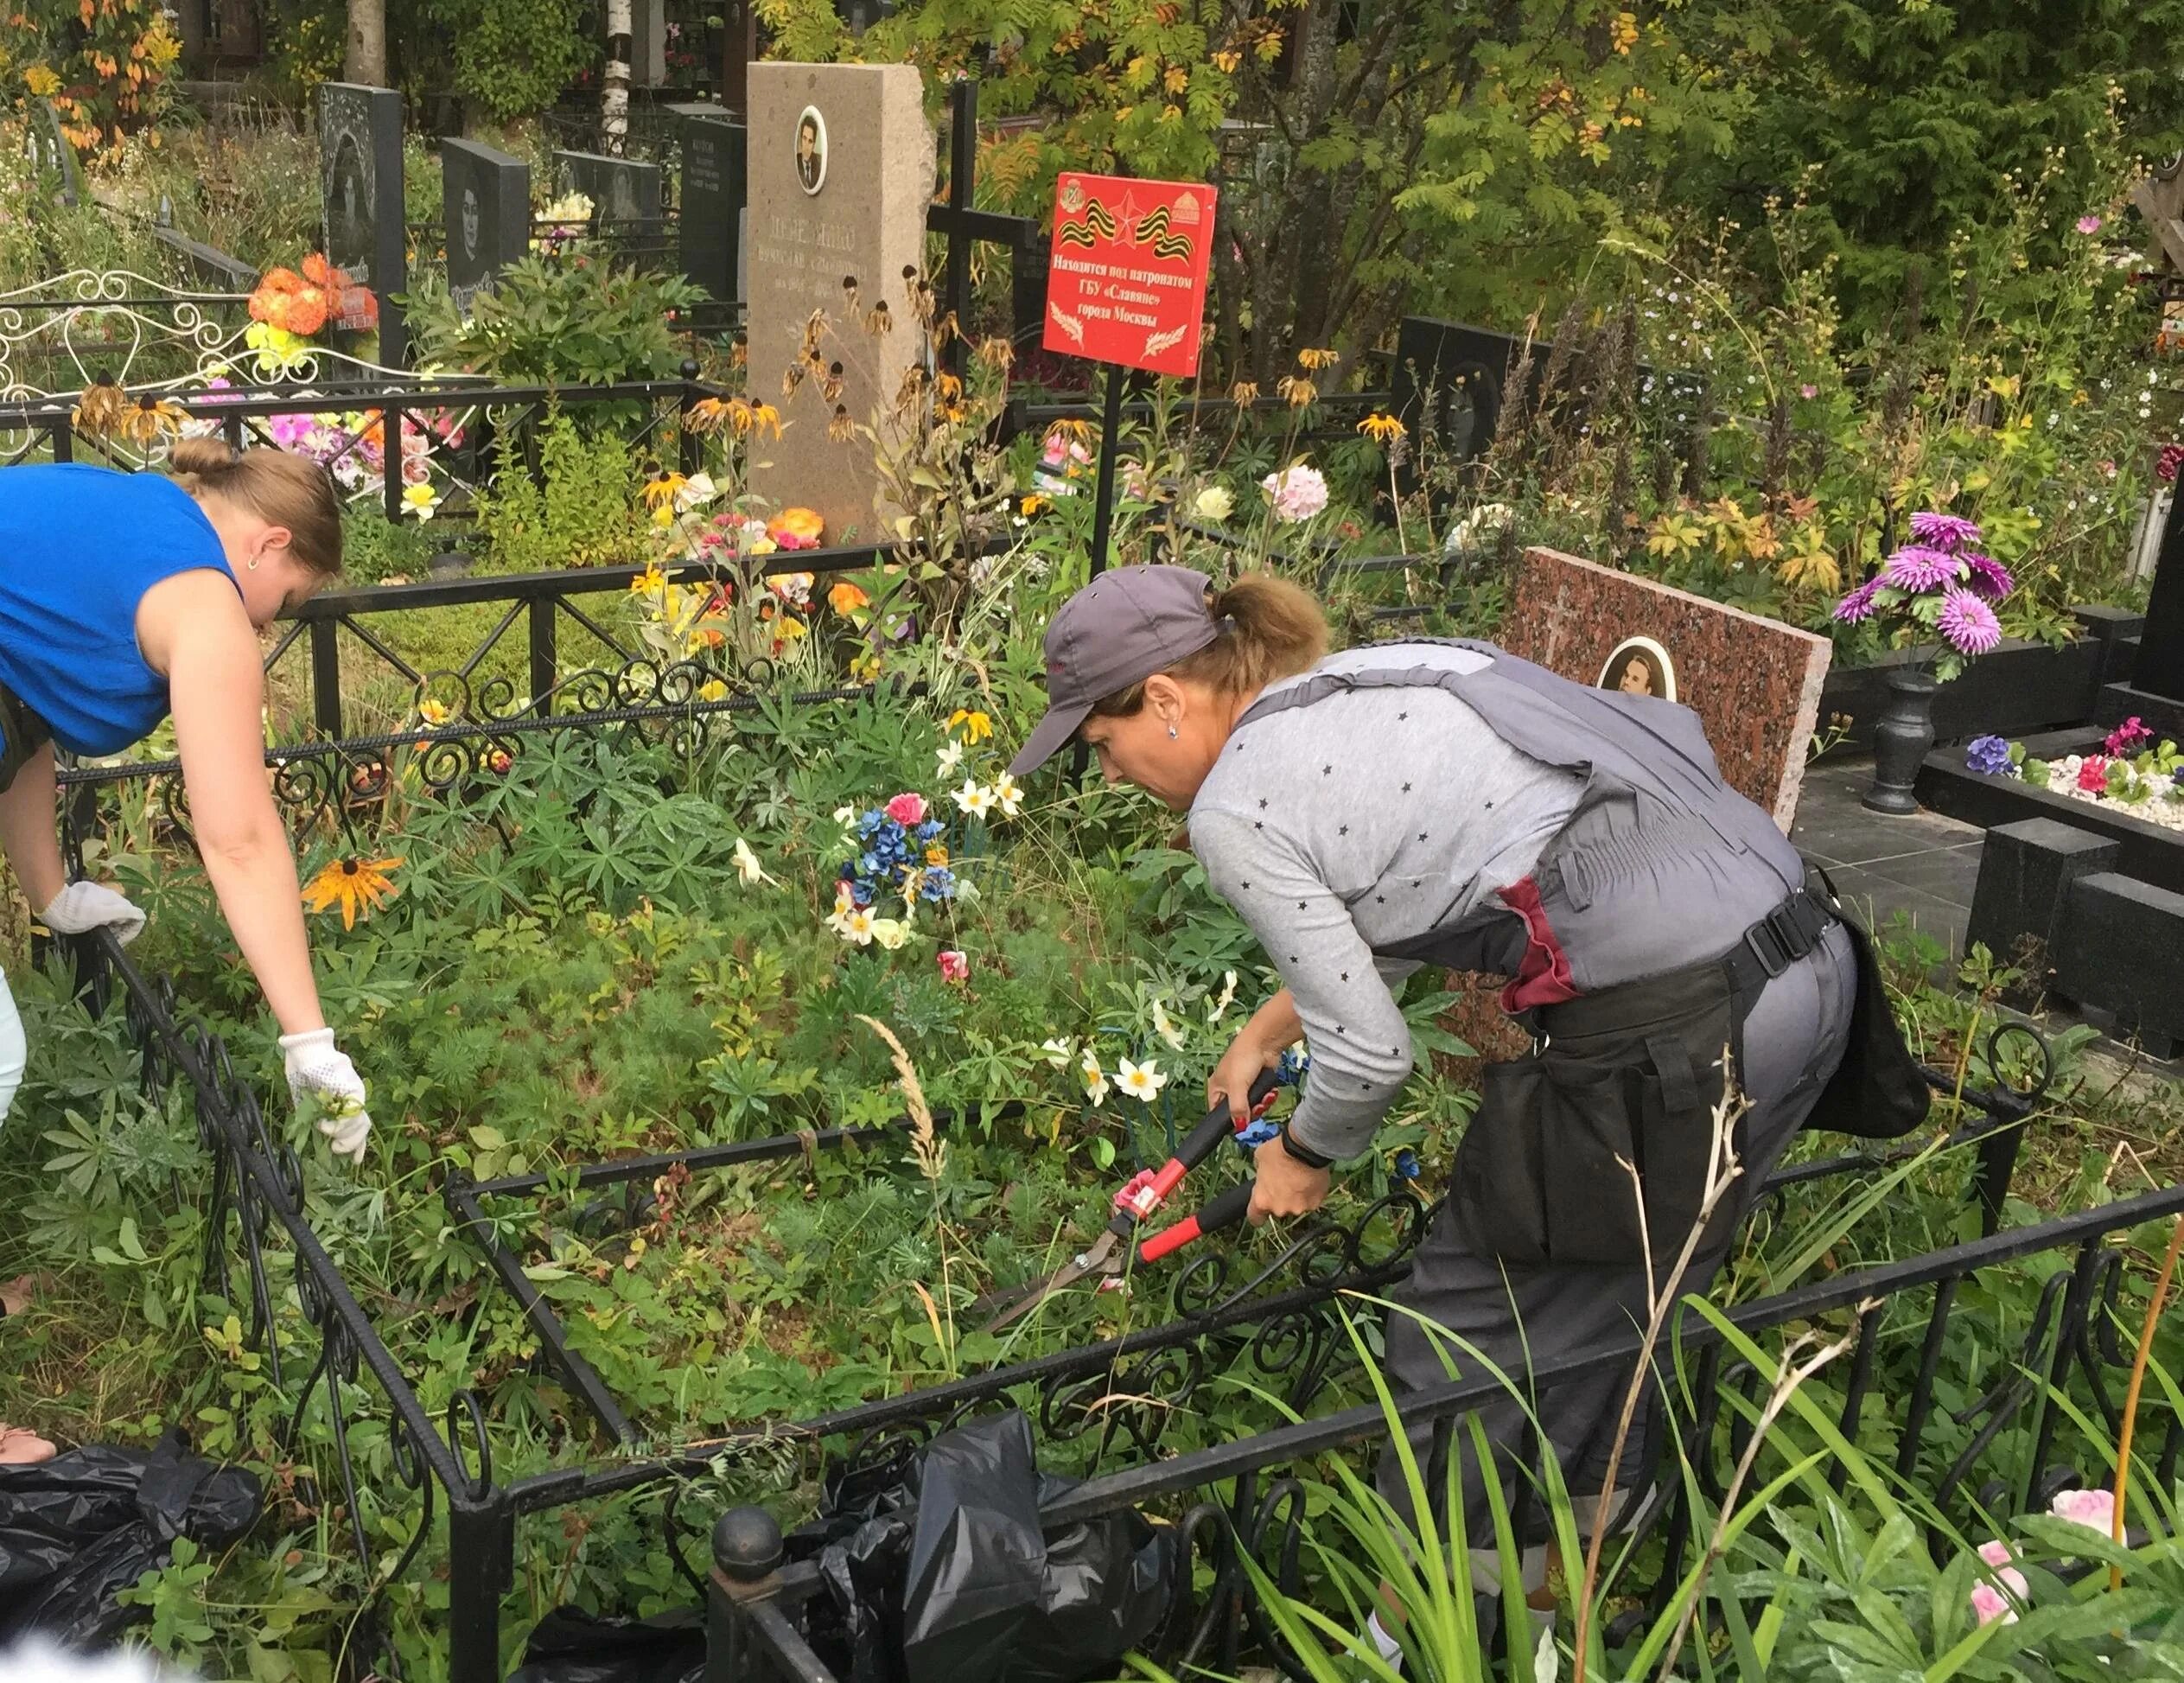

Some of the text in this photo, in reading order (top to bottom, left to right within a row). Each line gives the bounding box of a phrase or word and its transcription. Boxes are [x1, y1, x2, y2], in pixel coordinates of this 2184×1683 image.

[1053, 254, 1107, 276] Находится
[1109, 265, 1127, 279] под
[1130, 269, 1193, 289] патронатом
[1079, 278, 1161, 306] ГБУ «Славяне»
[1078, 303, 1157, 328] города Москвы
